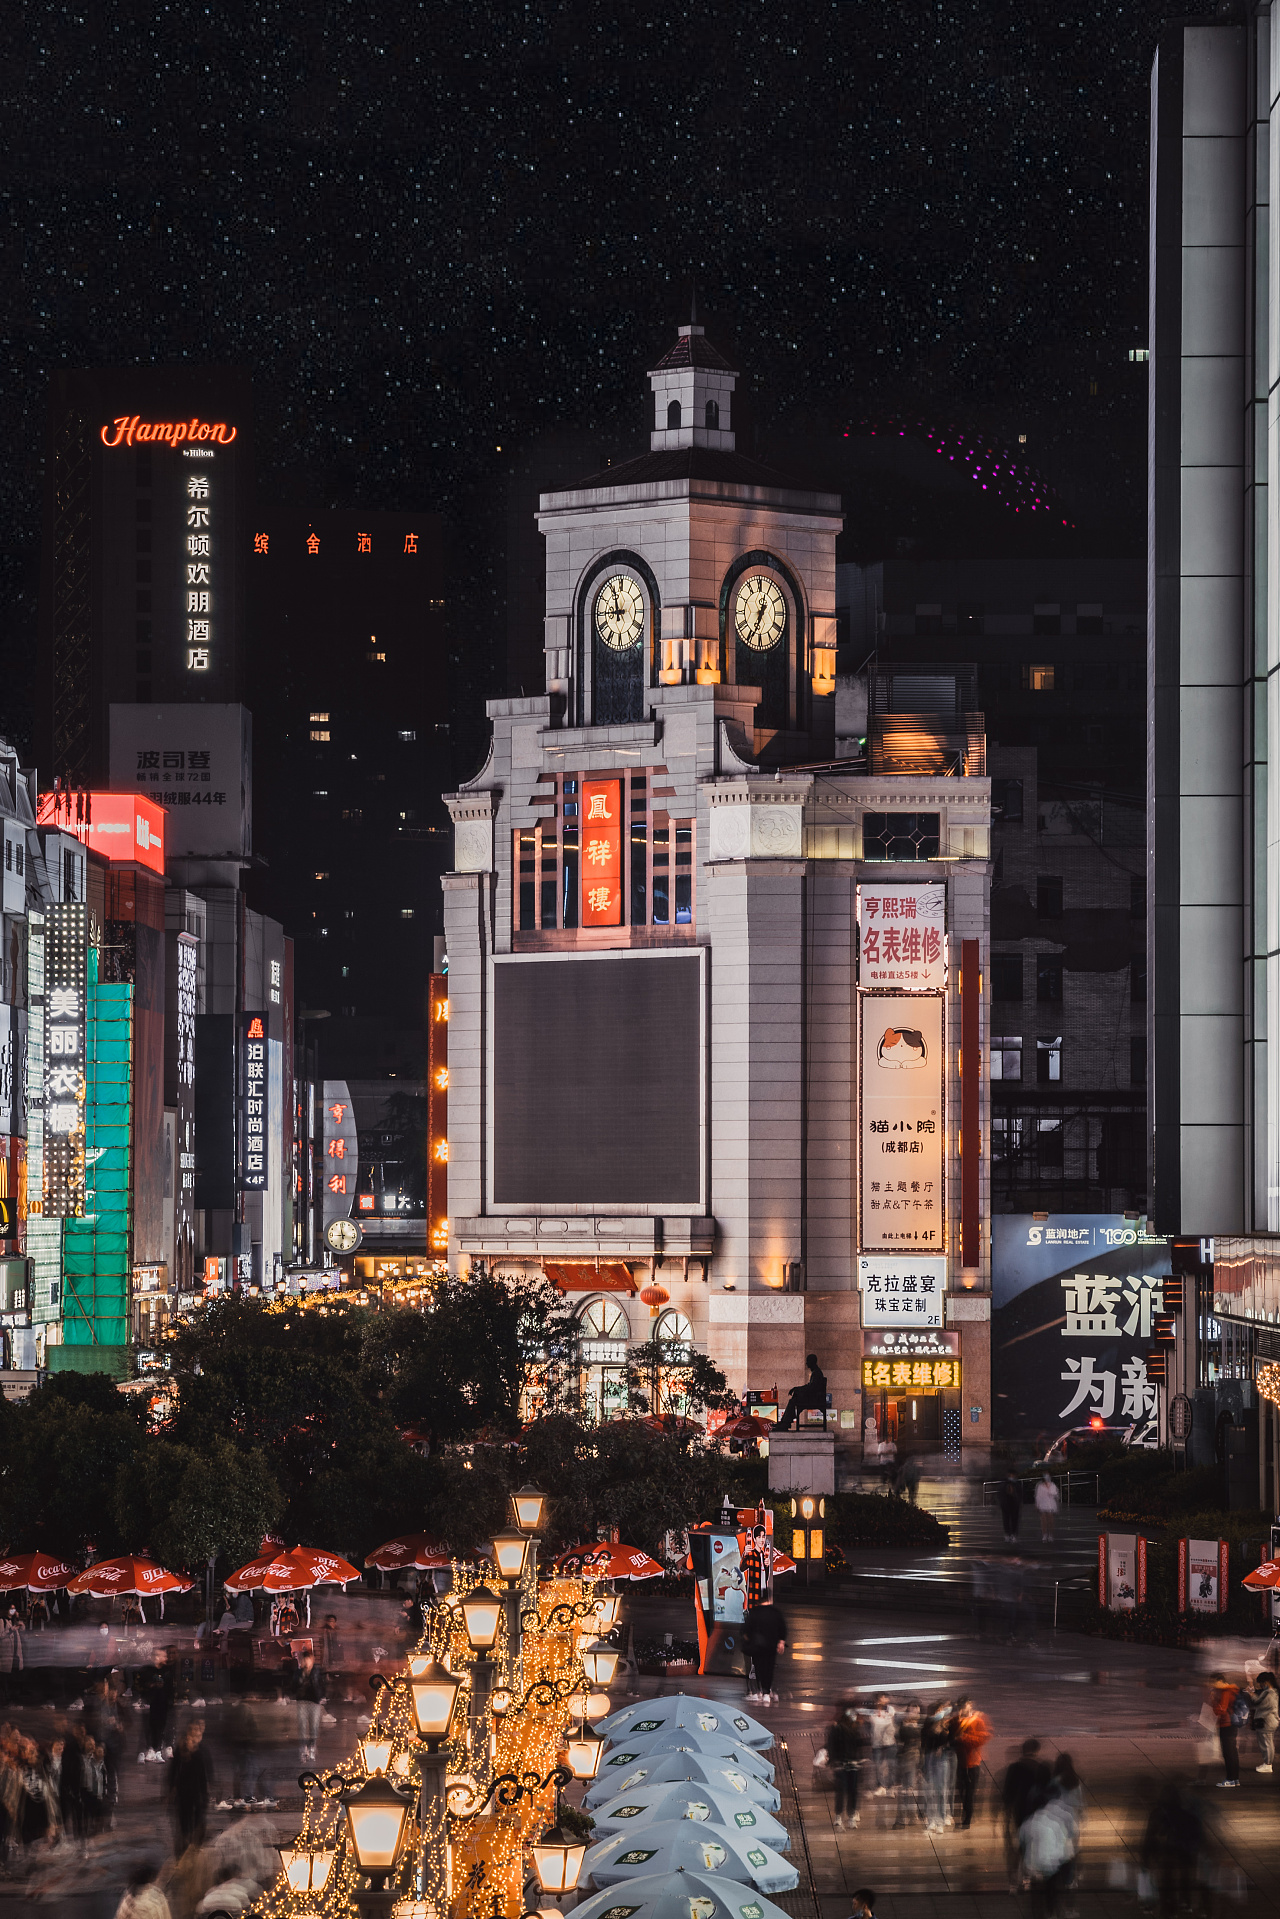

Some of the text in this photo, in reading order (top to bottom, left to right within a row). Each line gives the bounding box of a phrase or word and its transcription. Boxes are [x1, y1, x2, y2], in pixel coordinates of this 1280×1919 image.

[101, 415, 237, 447] Hampton
[190, 449, 214, 457] Hilton
[254, 532, 419, 554] 缤舍酒店
[187, 477, 209, 670] 希尔顿欢朋酒店
[137, 751, 211, 769] 波司登
[137, 772, 211, 782] 畅销全球72国
[864, 897, 917, 919] 亨熙瑞
[863, 926, 941, 964] 名表维修
[870, 971, 919, 980] 电梯直达5楼
[50, 988, 79, 1133] 美丽衣橱
[247, 1044, 264, 1171] 泊联汇时尚酒店
[869, 1120, 936, 1133] 猫小院
[328, 1103, 348, 1194] 亨得利
[881, 1141, 924, 1153] (成都店)
[871, 1181, 934, 1192] 猫主题餐厅
[871, 1199, 934, 1210] 甜点&下午茶
[922, 1231, 936, 1240] 4F
[1045, 1228, 1090, 1239] 蓝润地产
[867, 1274, 936, 1293] 克拉盛宴
[875, 1298, 927, 1312] 珠宝定制
[928, 1315, 940, 1325] 2F
[872, 1362, 953, 1386] 名表维修
[240, 1563, 297, 1580] Coca-Cola
